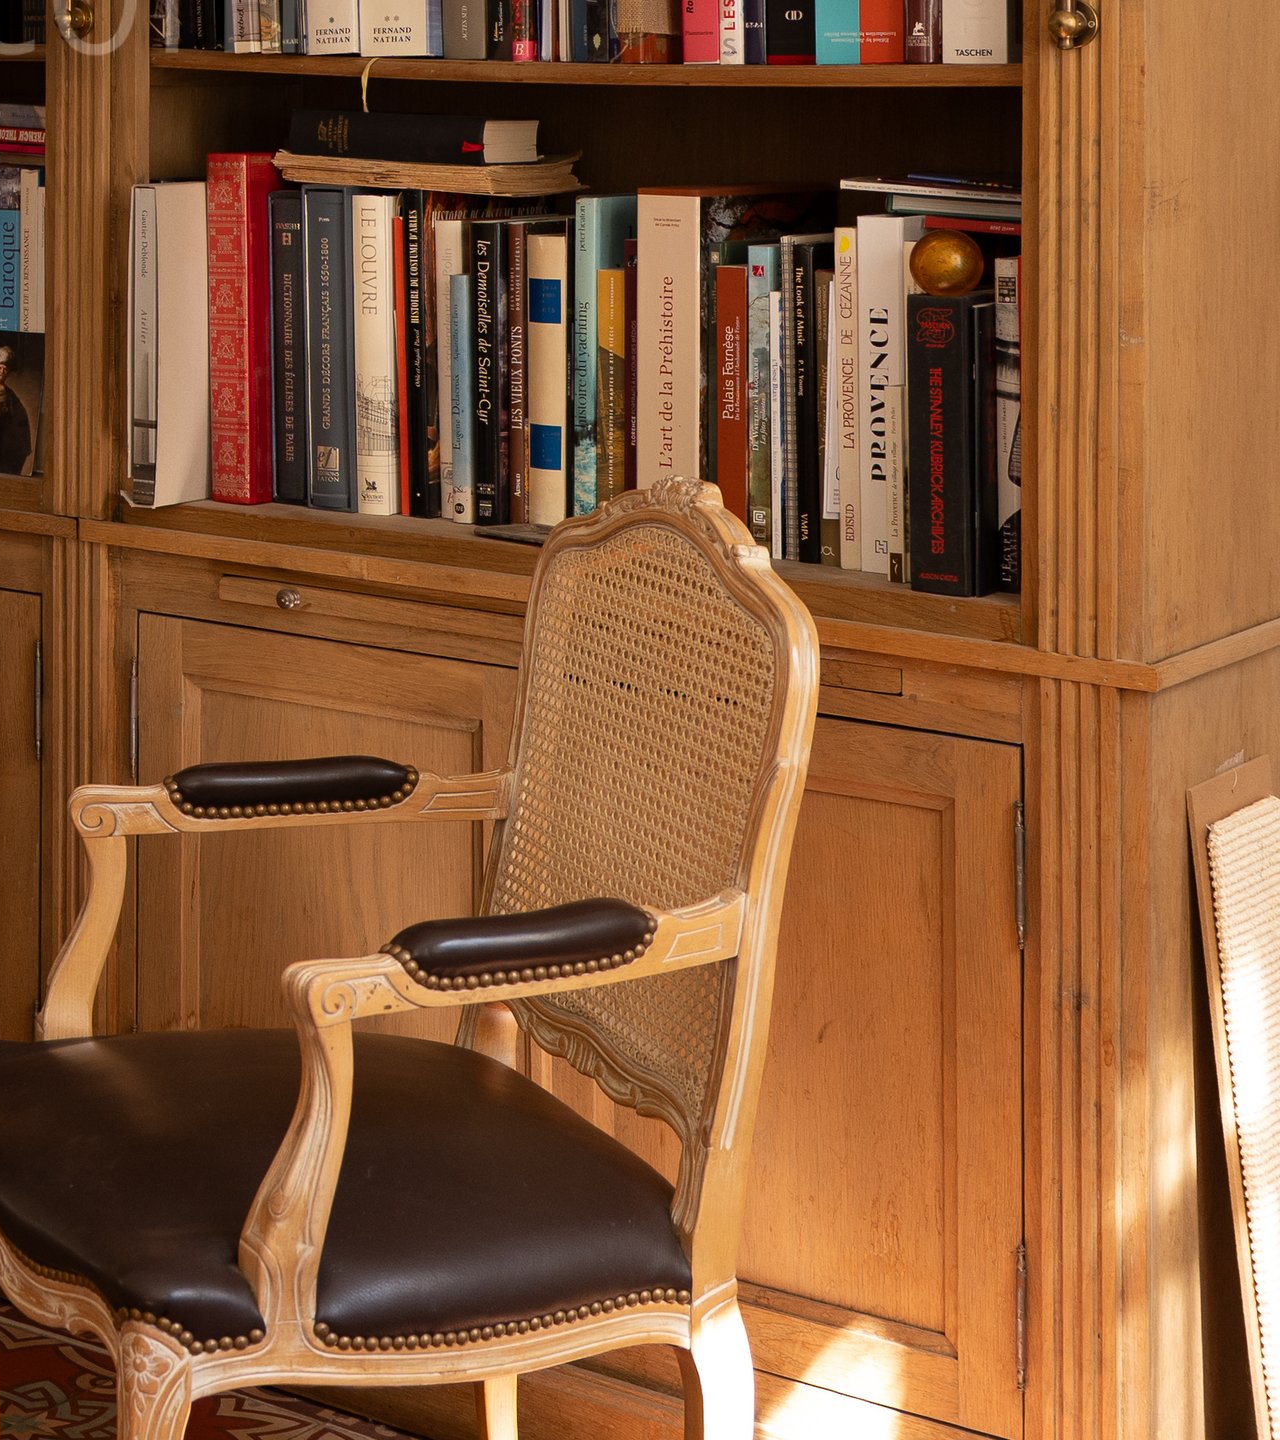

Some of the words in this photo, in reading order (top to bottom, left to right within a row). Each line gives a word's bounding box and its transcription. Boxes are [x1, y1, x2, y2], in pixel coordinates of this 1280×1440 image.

[316, 36, 350, 44] NATHAN
[373, 27, 412, 35] FERNAND
[373, 35, 412, 43] NATHAN
[361, 208, 376, 227] LE
[321, 237, 330, 286] 1650-1800
[409, 243, 419, 275] COSTUME
[476, 240, 491, 256] les
[361, 236, 377, 315] LOUVRE
[410, 276, 419, 287] DU
[796, 267, 804, 283] The
[840, 256, 853, 319] CÉZANNE
[283, 273, 292, 345] DICTIONNAIRE
[410, 289, 419, 323] HISTOIRE
[477, 262, 491, 334] Demoiselles
[796, 285, 804, 306] Look
[321, 289, 332, 340] FRANÇAIS
[575, 301, 590, 357] yachting
[658, 276, 674, 376] Préhistoire
[478, 339, 491, 353] de
[511, 326, 522, 366] PONTS
[723, 326, 734, 375] Farnèse
[797, 321, 805, 346] Music
[841, 329, 853, 345] DE
[284, 350, 293, 369] DES
[478, 357, 491, 425] Saint-Cyr
[512, 368, 522, 403] VIEUX
[659, 380, 673, 397] la
[722, 380, 735, 420] Palais
[842, 357, 854, 430] PROVENCE
[870, 308, 889, 481] PROVENCE
[285, 415, 294, 429] DE
[322, 387, 330, 430] GRANDS
[512, 409, 522, 430] LES
[575, 379, 587, 430] histoire
[659, 401, 673, 422] de
[930, 388, 943, 438] STANLEY
[285, 435, 295, 462] PARIS
[659, 429, 673, 469] L'art
[843, 432, 855, 450] LA
[930, 440, 944, 493] KUBRICK
[845, 504, 855, 541] EDISUD
[931, 494, 945, 554] ARCHIVES
